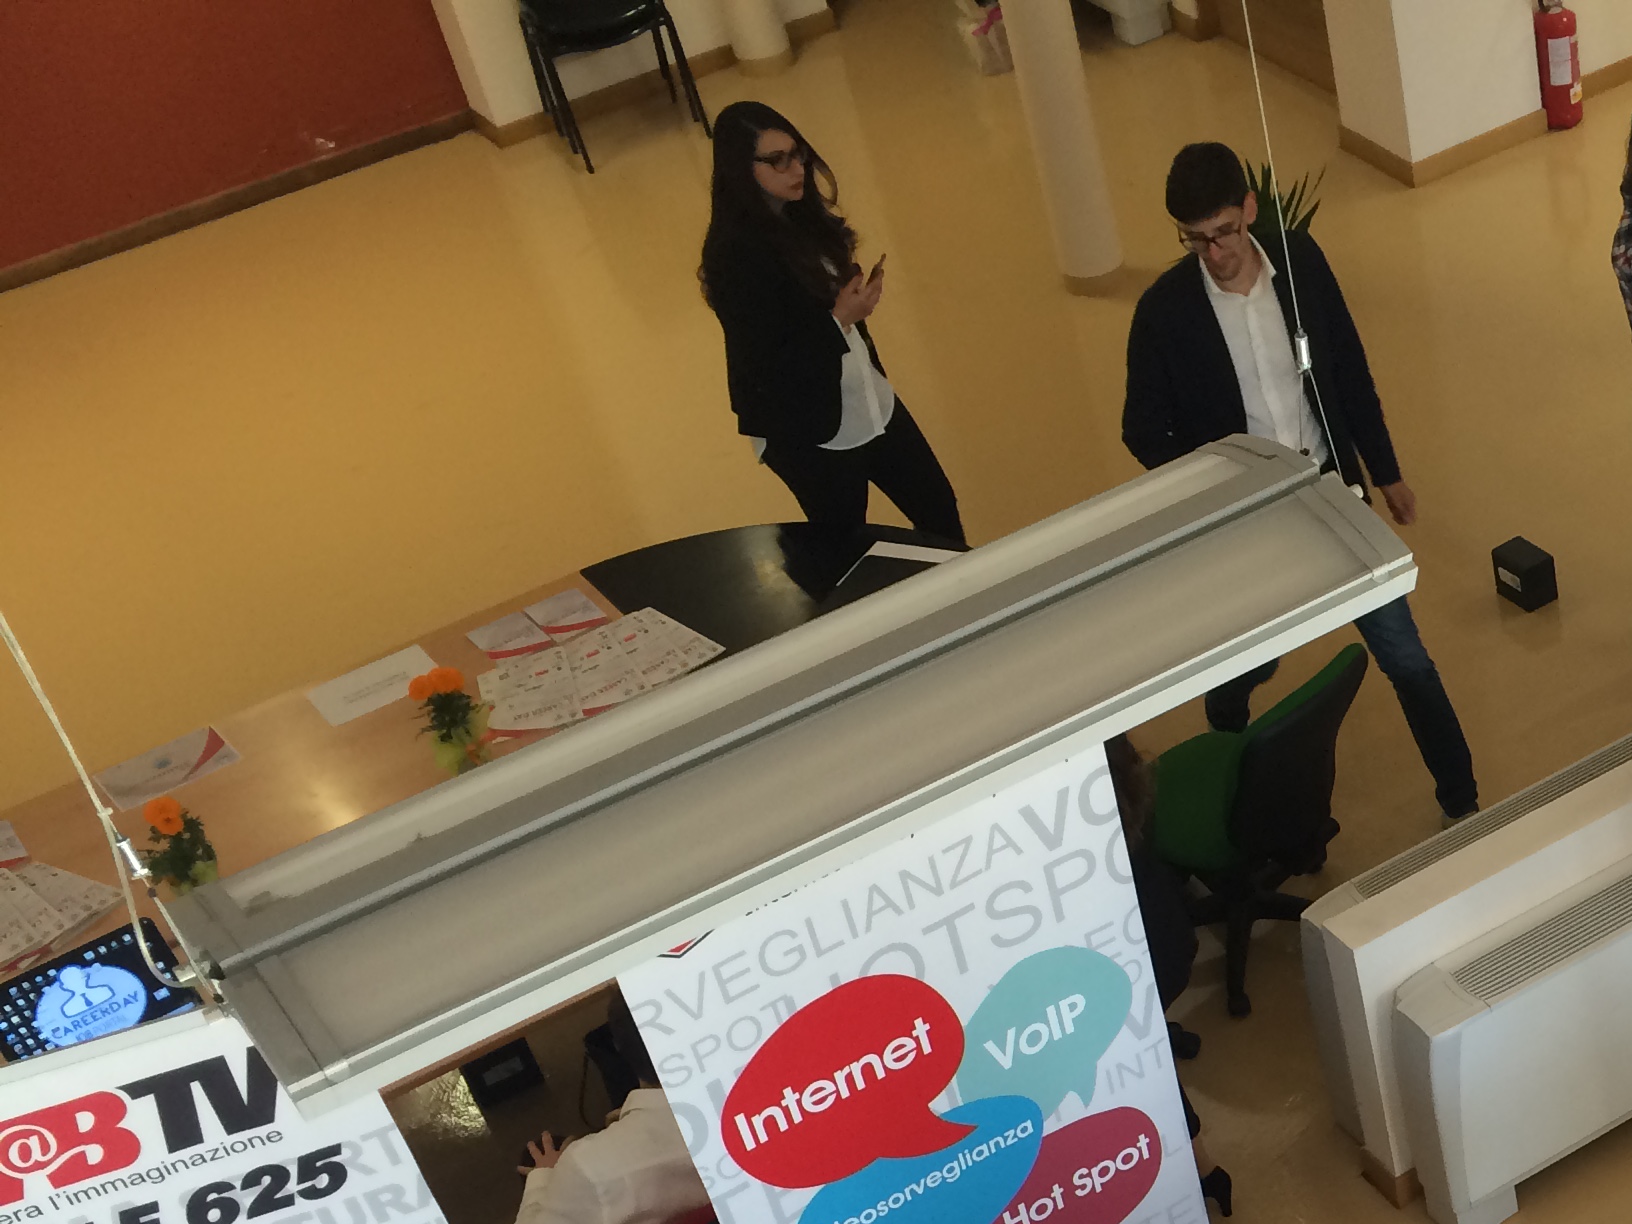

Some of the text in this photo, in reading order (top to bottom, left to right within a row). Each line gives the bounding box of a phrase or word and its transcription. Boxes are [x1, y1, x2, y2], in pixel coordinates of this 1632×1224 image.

[733, 1016, 935, 1152] Internet
[48, 1130, 284, 1210] l'immaginazione
[1071, 1133, 1152, 1201] Spot
